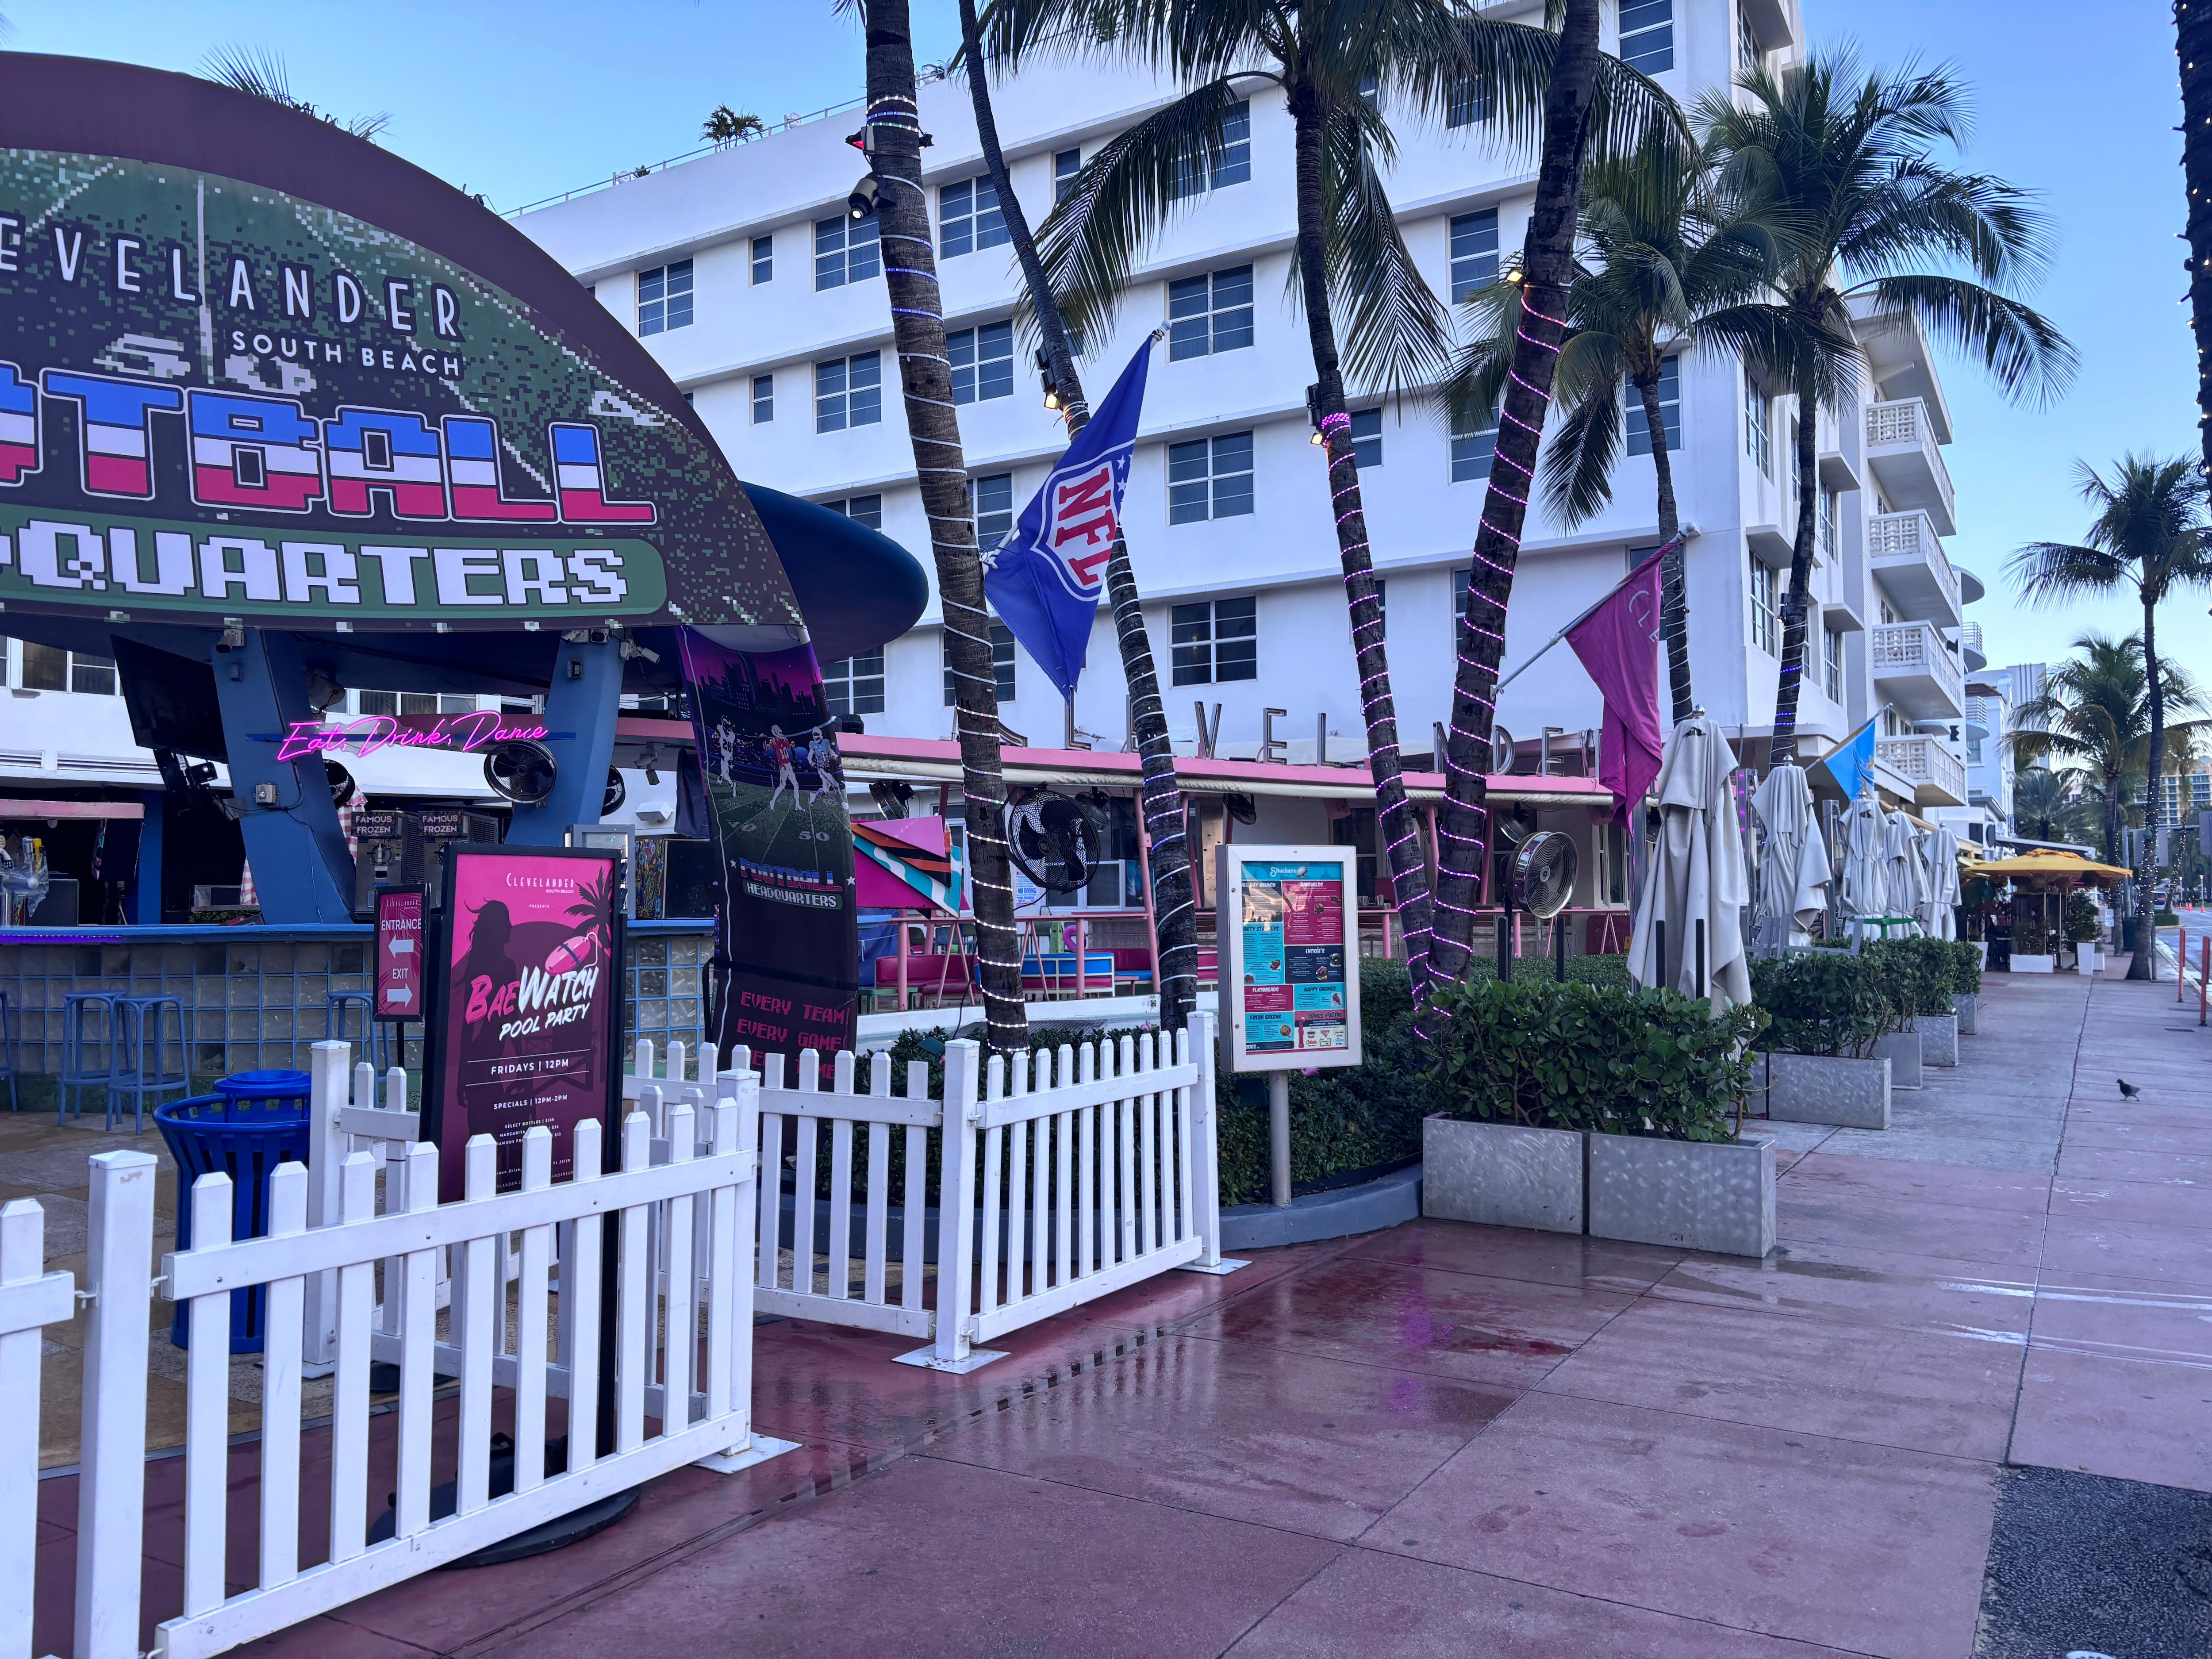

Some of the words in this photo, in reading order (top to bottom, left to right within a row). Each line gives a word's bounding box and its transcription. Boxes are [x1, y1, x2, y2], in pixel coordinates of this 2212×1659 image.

[232, 330, 343, 365] SOUTH
[361, 347, 461, 377] BEACH
[1054, 467, 1117, 587] NFL
[0, 520, 627, 606] QUARTERS
[450, 710, 549, 753] Dance
[506, 872, 575, 888] CLEVELANDER
[738, 857, 842, 892] FOOTBALL
[746, 882, 837, 907] HEADQUARTERS
[381, 918, 422, 931] ENTRANCE
[392, 968, 409, 979] EXIT
[740, 991, 792, 1015] EVERY
[499, 1017, 540, 1041] POOL
[545, 1002, 590, 1029] PARTY
[737, 1018, 788, 1043] EVERY
[798, 1032, 848, 1052] GAME!
[491, 1062, 535, 1075] FRIDAYS
[545, 1058, 569, 1070] 12PM
[493, 1099, 528, 1110] SPECIALS
[535, 1094, 568, 1104] 12PM-2PM
